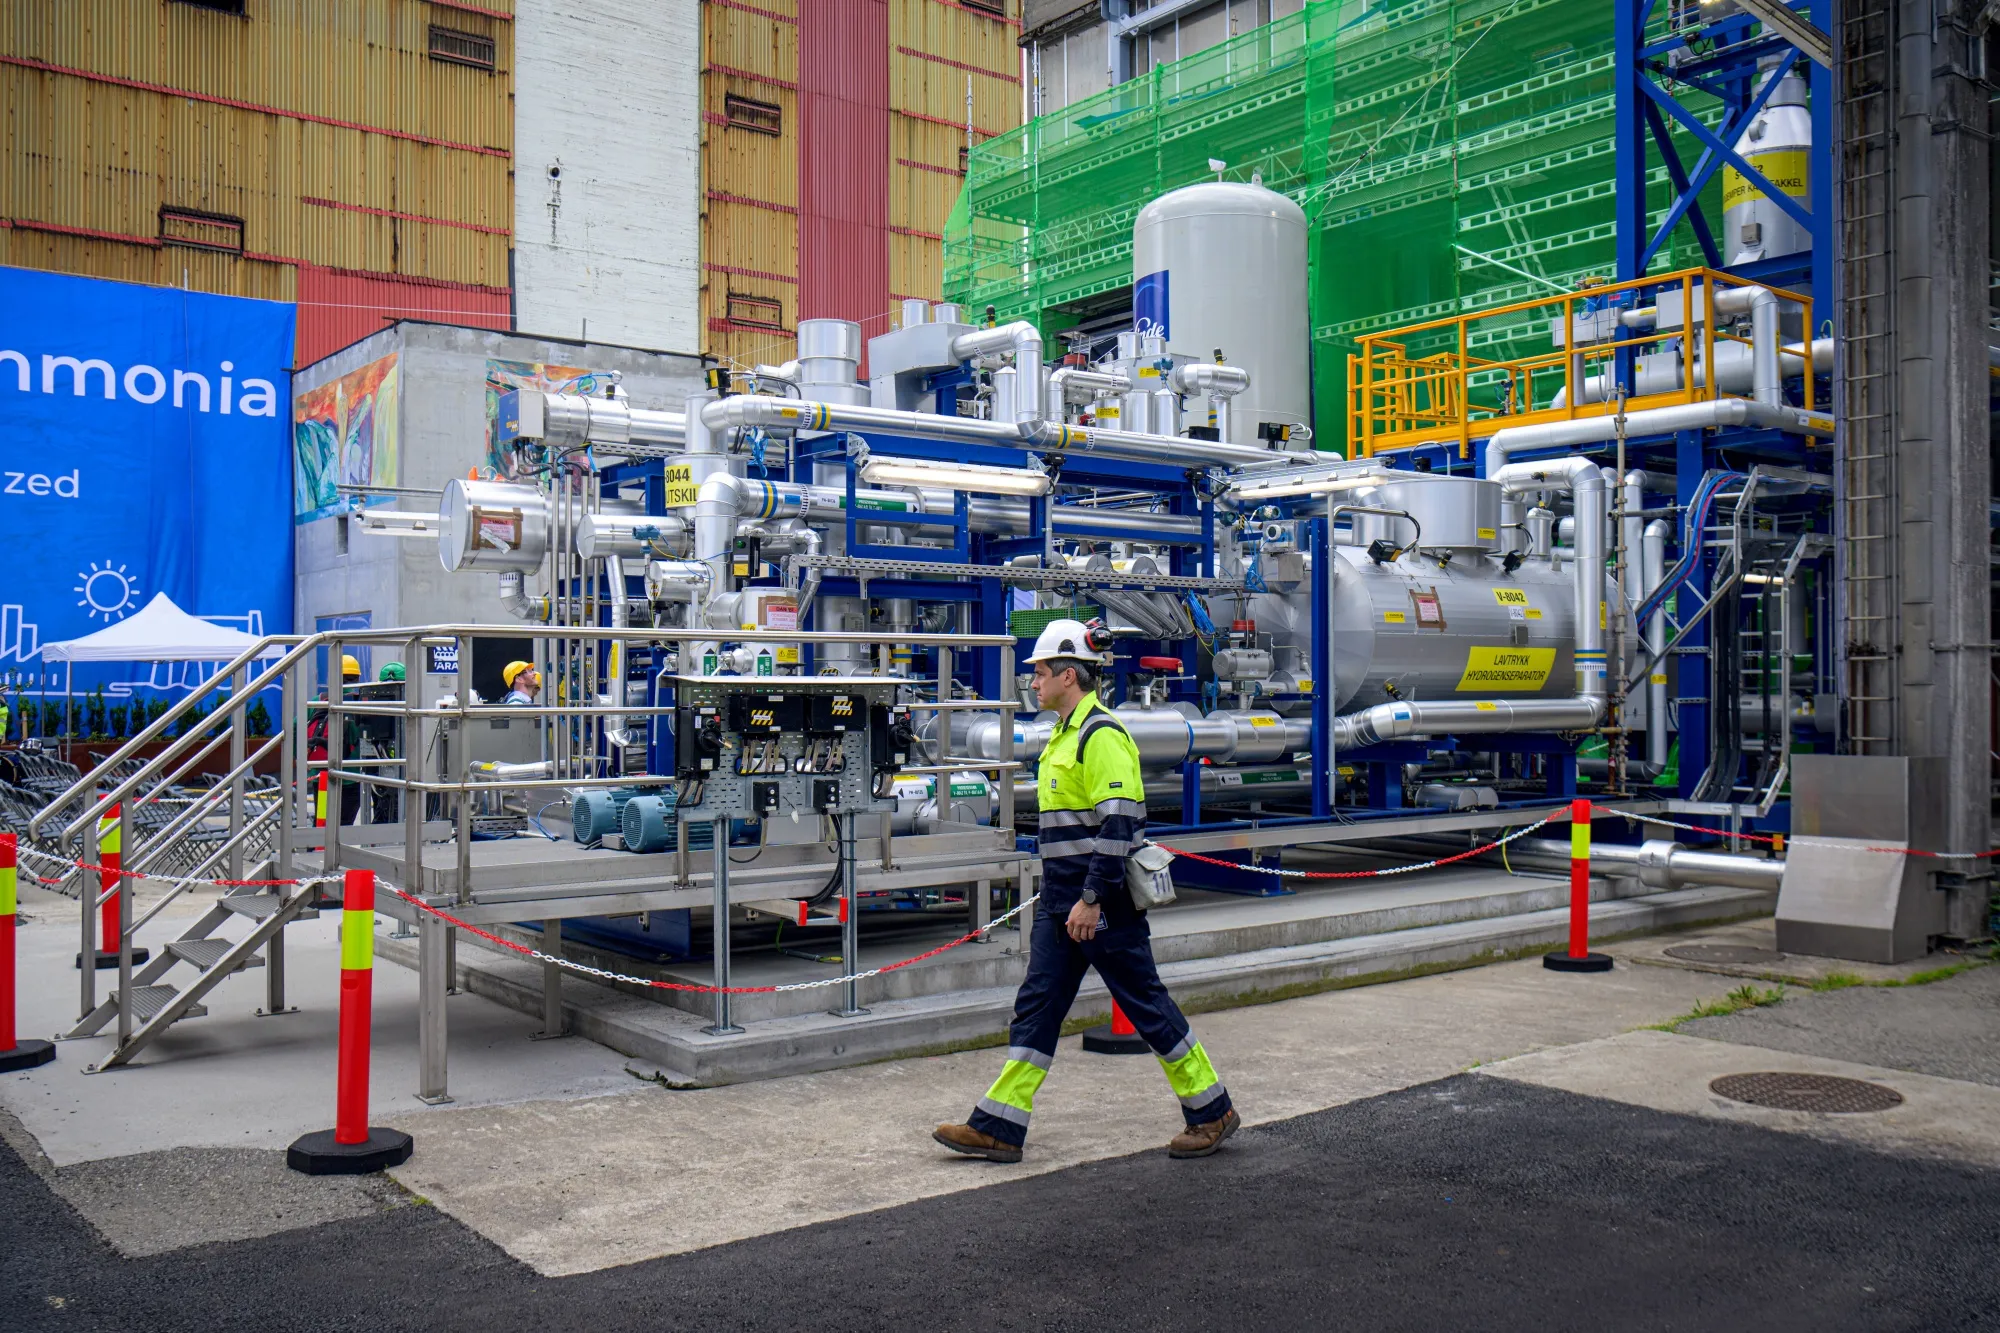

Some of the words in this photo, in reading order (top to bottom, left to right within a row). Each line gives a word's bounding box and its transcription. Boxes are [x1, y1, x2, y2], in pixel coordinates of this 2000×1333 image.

[3, 468, 80, 499] zed
[1496, 591, 1525, 602] V-8042
[1494, 655, 1530, 666] LAVTRYKK
[1466, 671, 1545, 680] HYDROGENSEPARATOR
